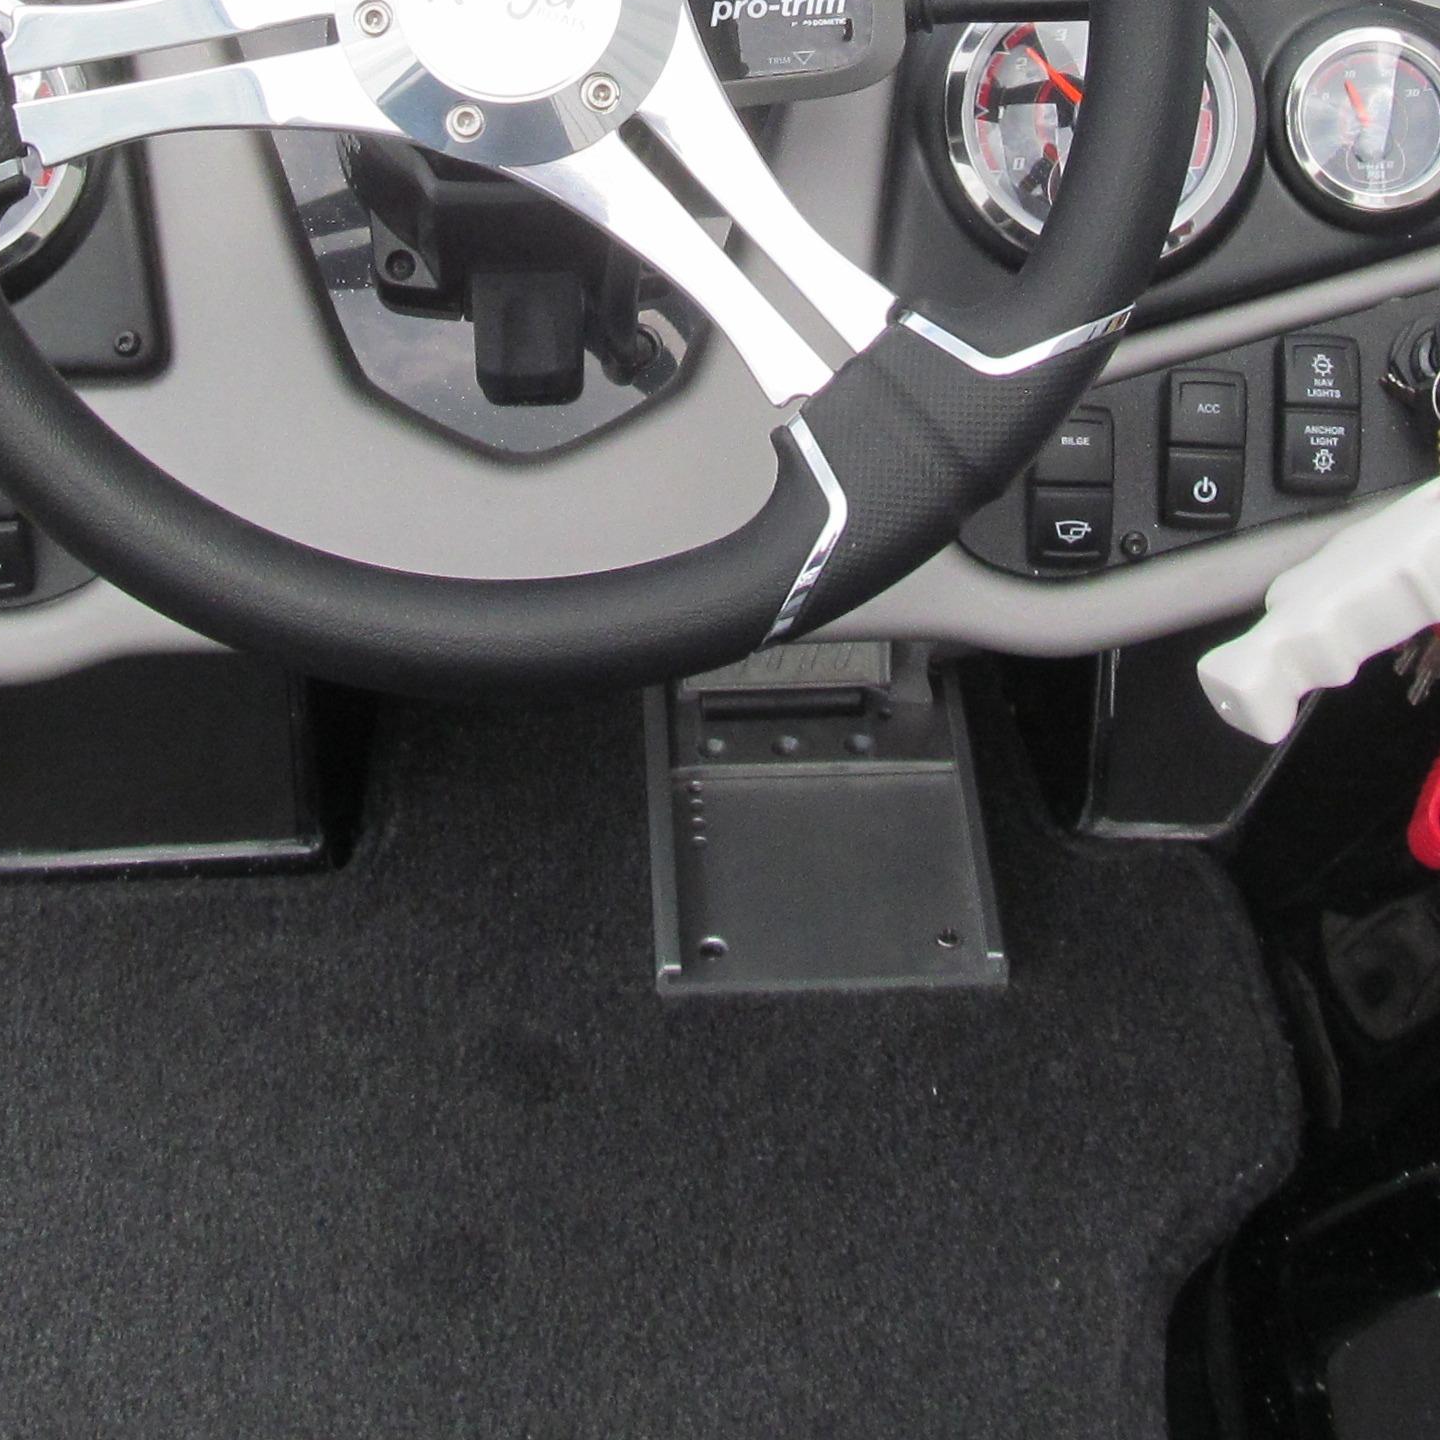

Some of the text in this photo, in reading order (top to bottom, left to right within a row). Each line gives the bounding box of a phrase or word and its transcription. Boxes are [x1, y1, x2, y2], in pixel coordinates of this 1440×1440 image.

[768, 56, 791, 64] TRIM
[1313, 378, 1334, 388] NAV
[1307, 388, 1341, 399] LIGHTS
[1197, 403, 1221, 414] ACC
[1304, 425, 1345, 436] ANCHOR
[1061, 436, 1090, 446] BILGE
[1310, 436, 1339, 447] LIGHT
